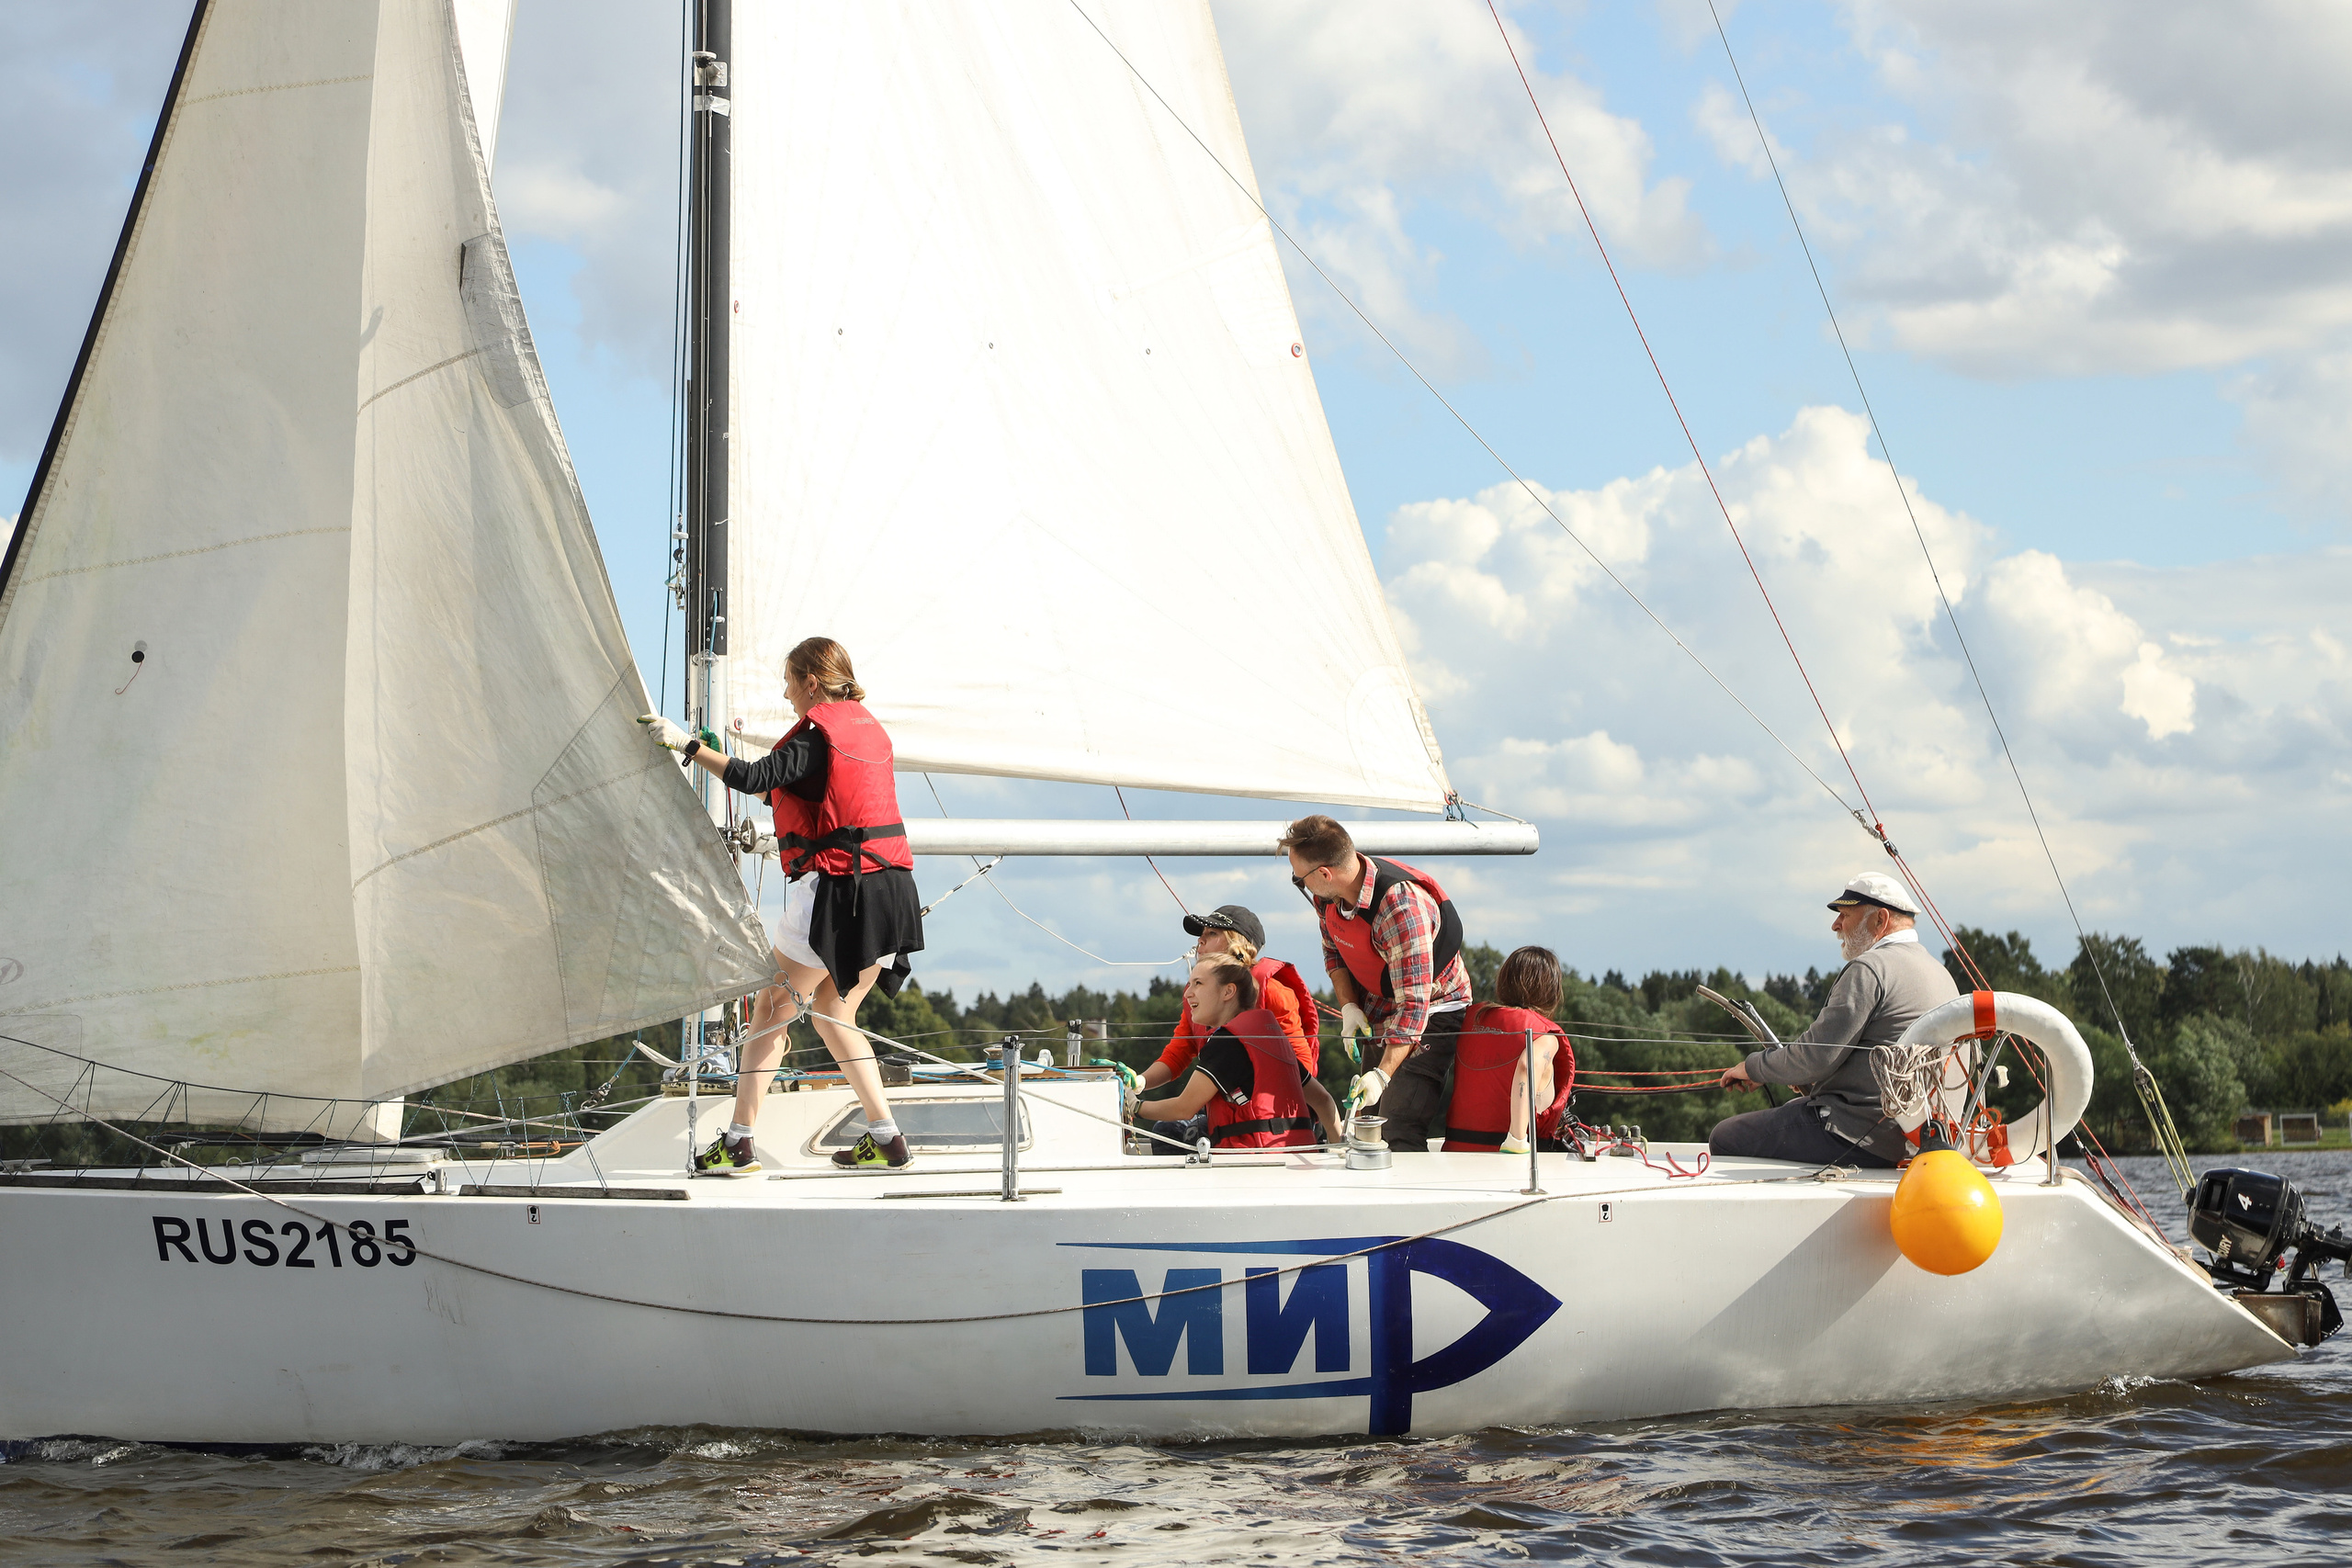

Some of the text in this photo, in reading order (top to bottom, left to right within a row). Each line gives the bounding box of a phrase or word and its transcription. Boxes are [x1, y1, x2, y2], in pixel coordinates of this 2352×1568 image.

[2237, 1192, 2253, 1212] 4
[152, 1215, 416, 1269] RUS2185
[1056, 1235, 1563, 1435] МИР
